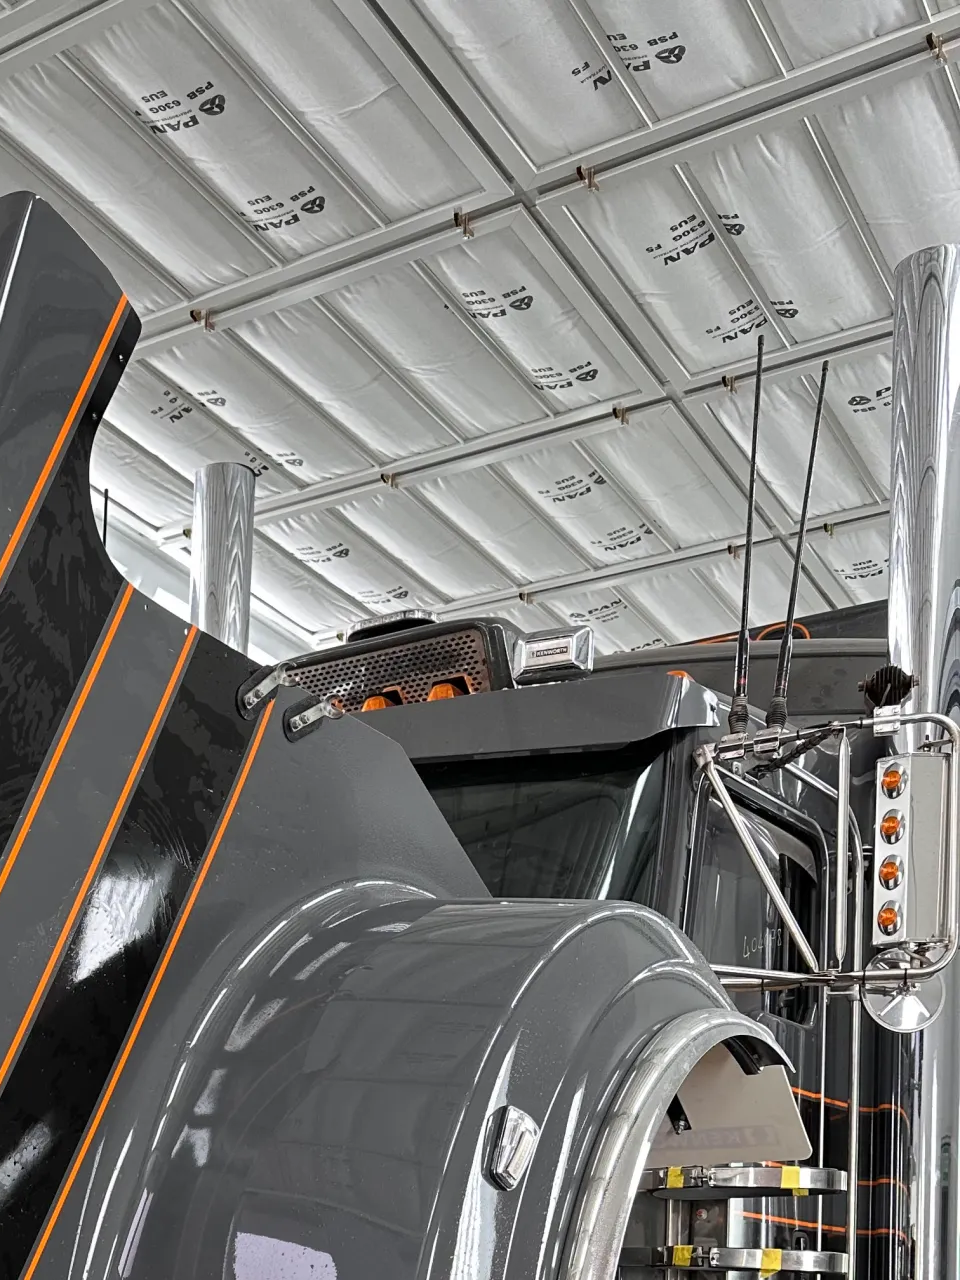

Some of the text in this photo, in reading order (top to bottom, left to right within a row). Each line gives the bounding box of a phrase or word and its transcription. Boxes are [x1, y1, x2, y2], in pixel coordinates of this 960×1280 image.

[606, 33, 628, 41] EU
[647, 31, 679, 47] PSB
[571, 61, 591, 77] F5
[141, 90, 169, 103] EU5
[149, 81, 214, 114] PSB 630G
[149, 114, 200, 135] PAN
[247, 194, 273, 206] EU5
[289, 185, 316, 202] PSB
[253, 213, 301, 232] PAN
[669, 214, 698, 233] EU5
[645, 243, 663, 254] F5
[663, 232, 716, 266] PAN
[502, 286, 527, 299] PSB
[728, 299, 754, 316] EU5
[722, 316, 769, 344] PAN
[568, 361, 593, 373] PSB
[552, 486, 592, 503] PAN
[844, 569, 884, 580] PAN
[535, 646, 569, 658] KENWORTH
